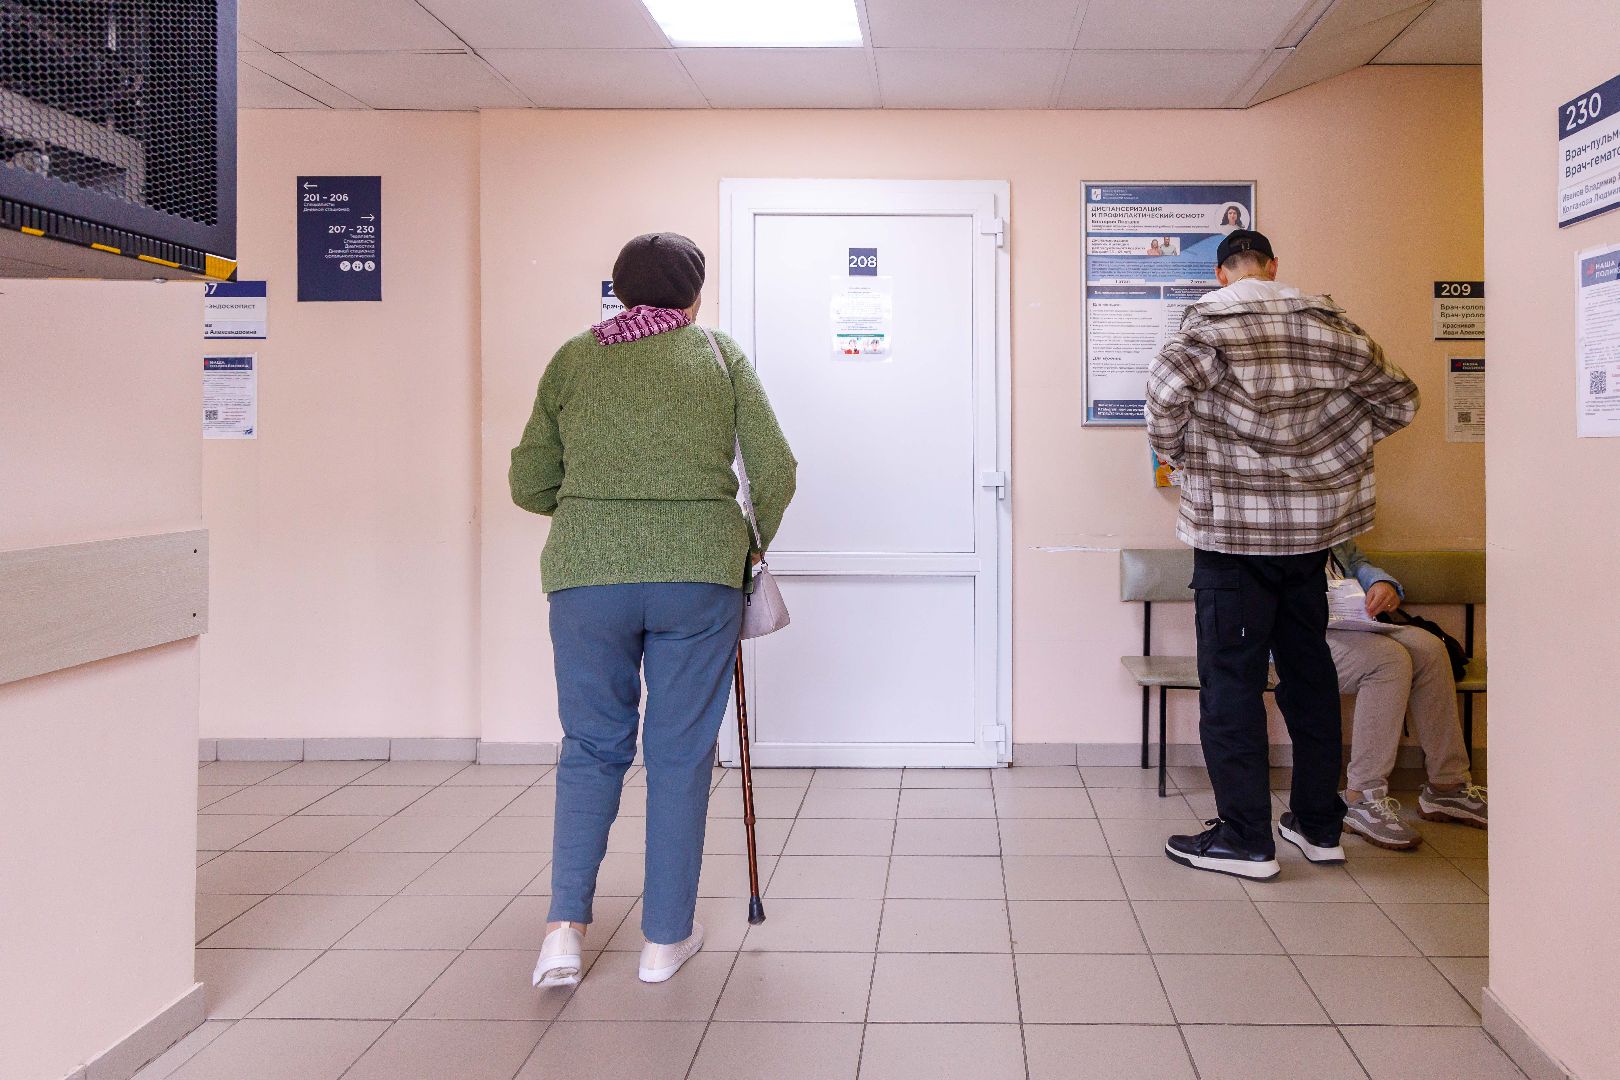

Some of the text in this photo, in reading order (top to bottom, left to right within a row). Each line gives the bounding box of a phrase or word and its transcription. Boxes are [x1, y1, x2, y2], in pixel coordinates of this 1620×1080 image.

[1566, 92, 1602, 131] 230
[1565, 129, 1620, 162] Врач-пульм
[303, 193, 320, 202] 201
[329, 193, 349, 202] 206
[1098, 211, 1174, 219] ПРОФИЛАКТИЧЕСКИЙ
[328, 225, 346, 234] 207
[356, 225, 375, 234] 230
[849, 255, 877, 268] 208
[1595, 260, 1616, 270] НАША
[1441, 283, 1472, 296] 209
